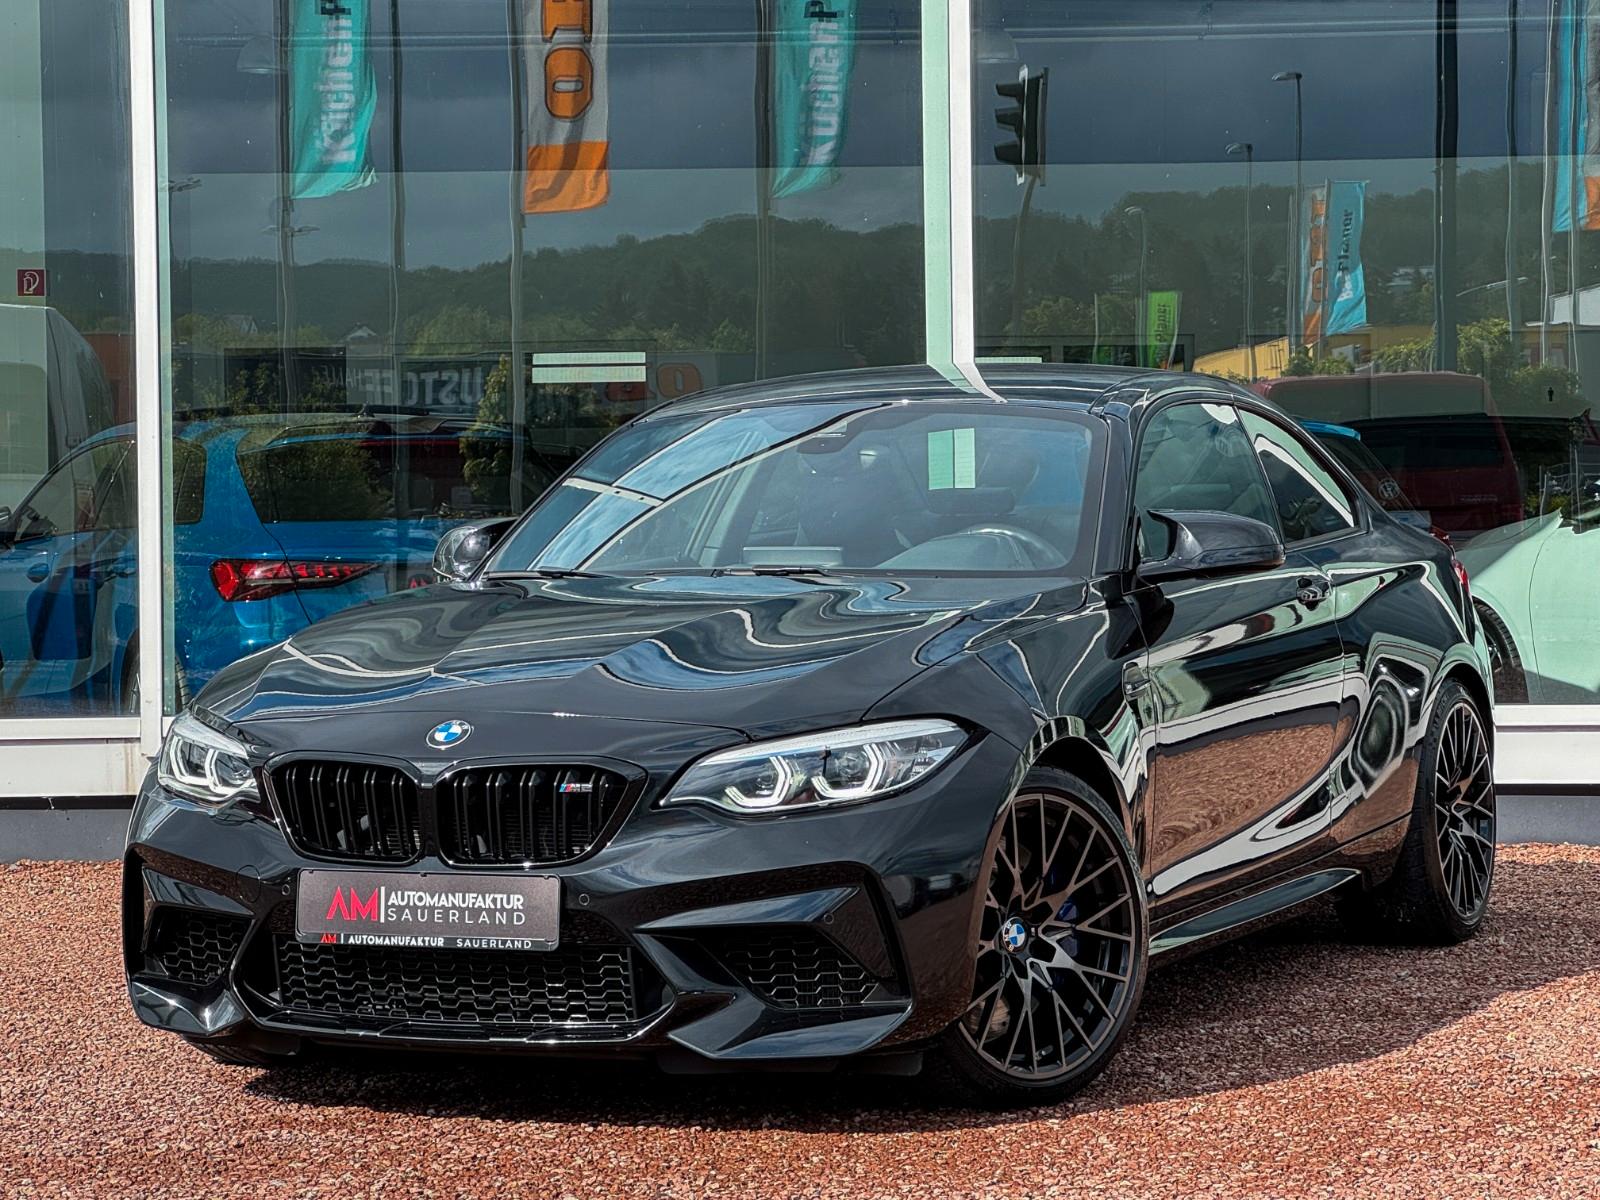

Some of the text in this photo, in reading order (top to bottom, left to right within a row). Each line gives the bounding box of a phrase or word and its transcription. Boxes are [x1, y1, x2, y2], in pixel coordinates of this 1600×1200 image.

[326, 885, 379, 922] AM
[387, 891, 524, 910] AUTOMANUFAKTUR
[387, 907, 526, 926] SAUERLAND
[348, 934, 445, 947] AUTOMANUFAKTUR
[456, 938, 532, 949] SAUERLAND
